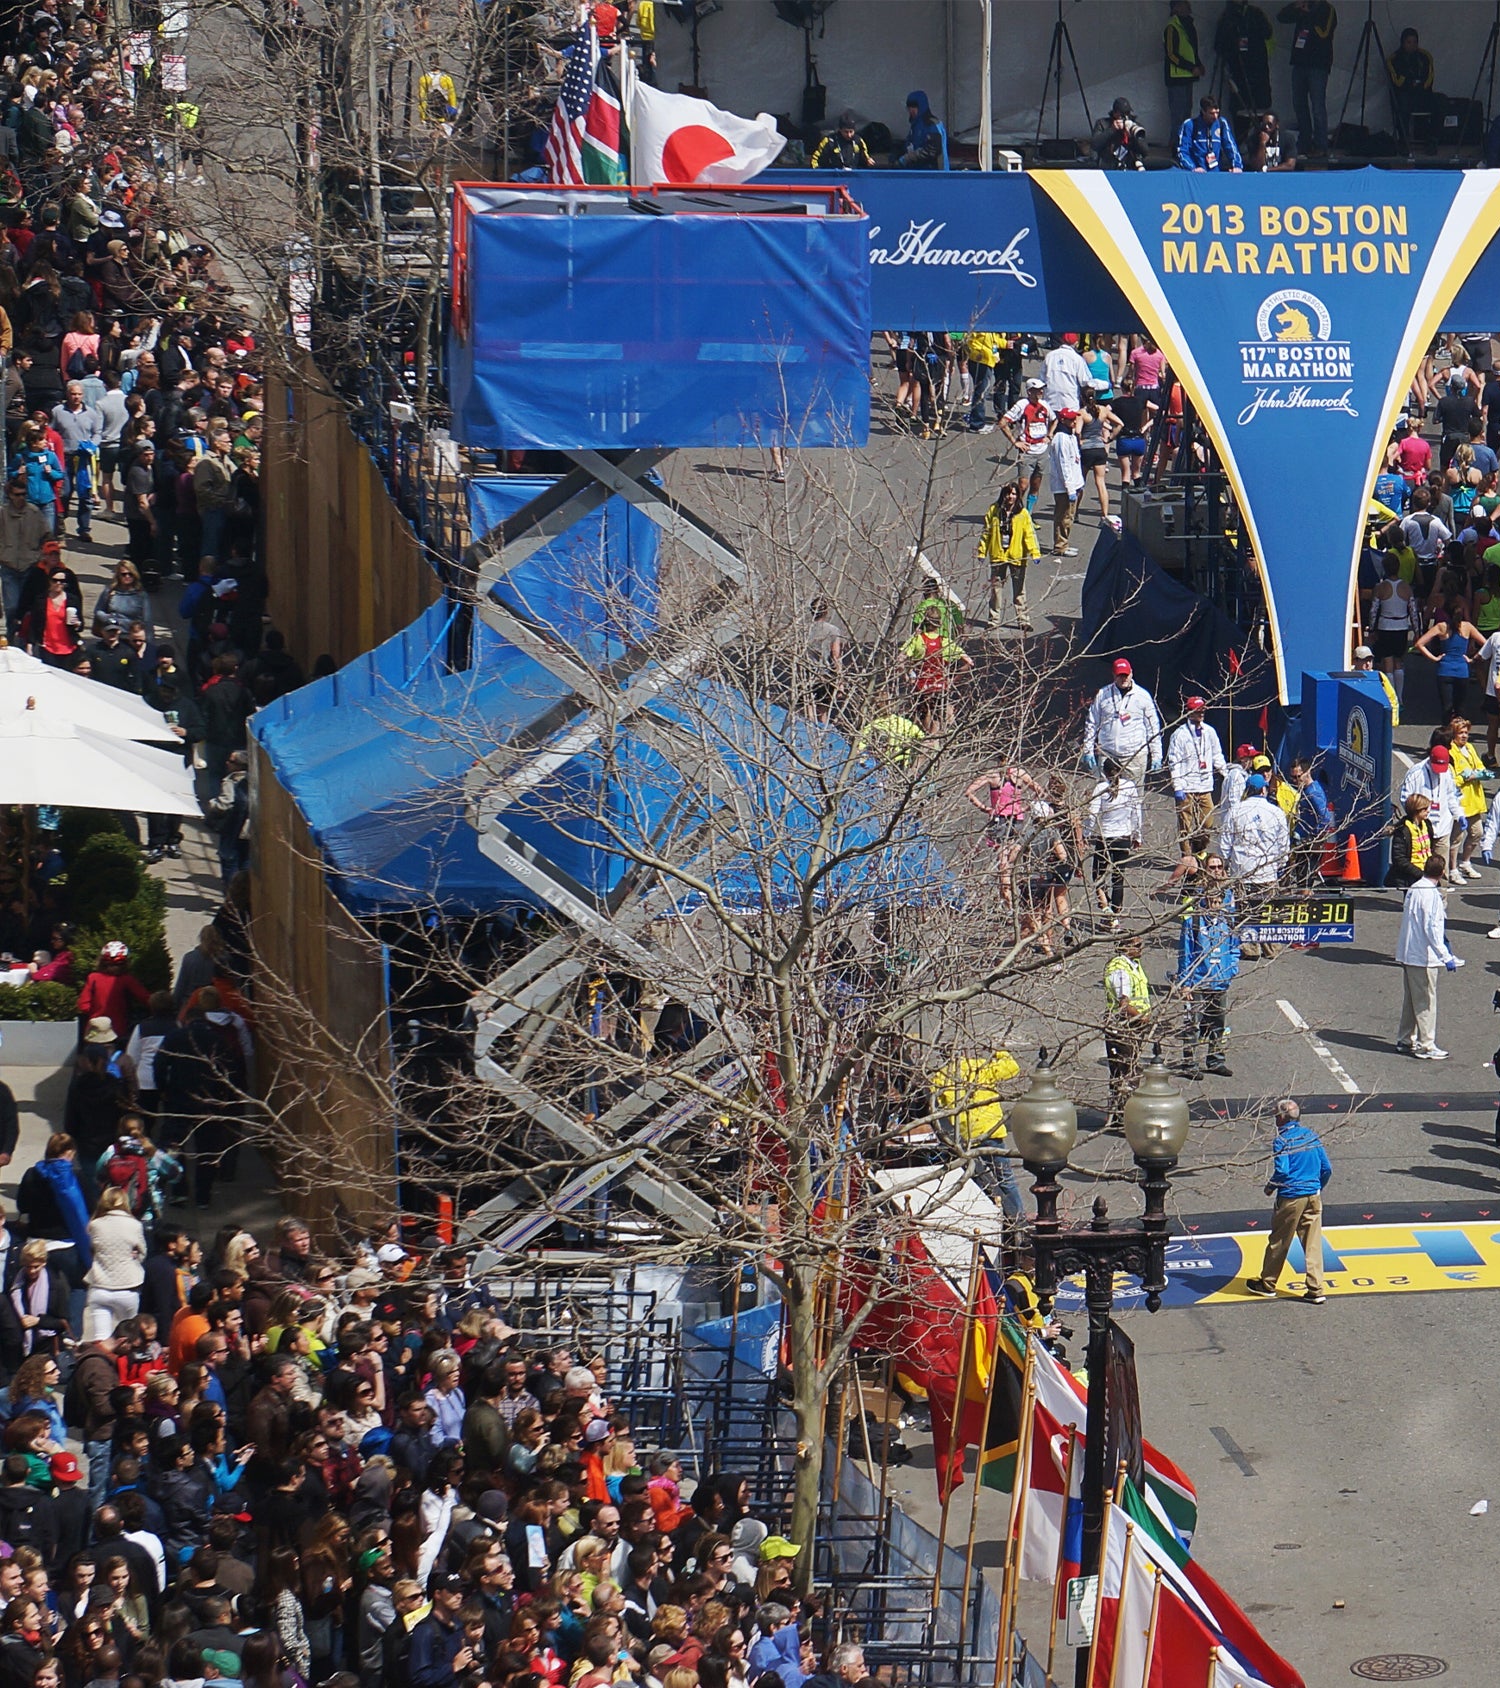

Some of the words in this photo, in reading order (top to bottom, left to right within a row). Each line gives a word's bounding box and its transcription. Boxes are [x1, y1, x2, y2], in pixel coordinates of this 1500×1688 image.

[1161, 203, 1245, 235] 2013
[1259, 205, 1408, 236] BOSTON
[1267, 291, 1300, 310] ATHLETIC
[1301, 292, 1330, 338] ASSOCIATION
[1278, 346, 1351, 361] BOSTON
[1237, 386, 1285, 426] John
[1260, 903, 1349, 924] 3:36:30
